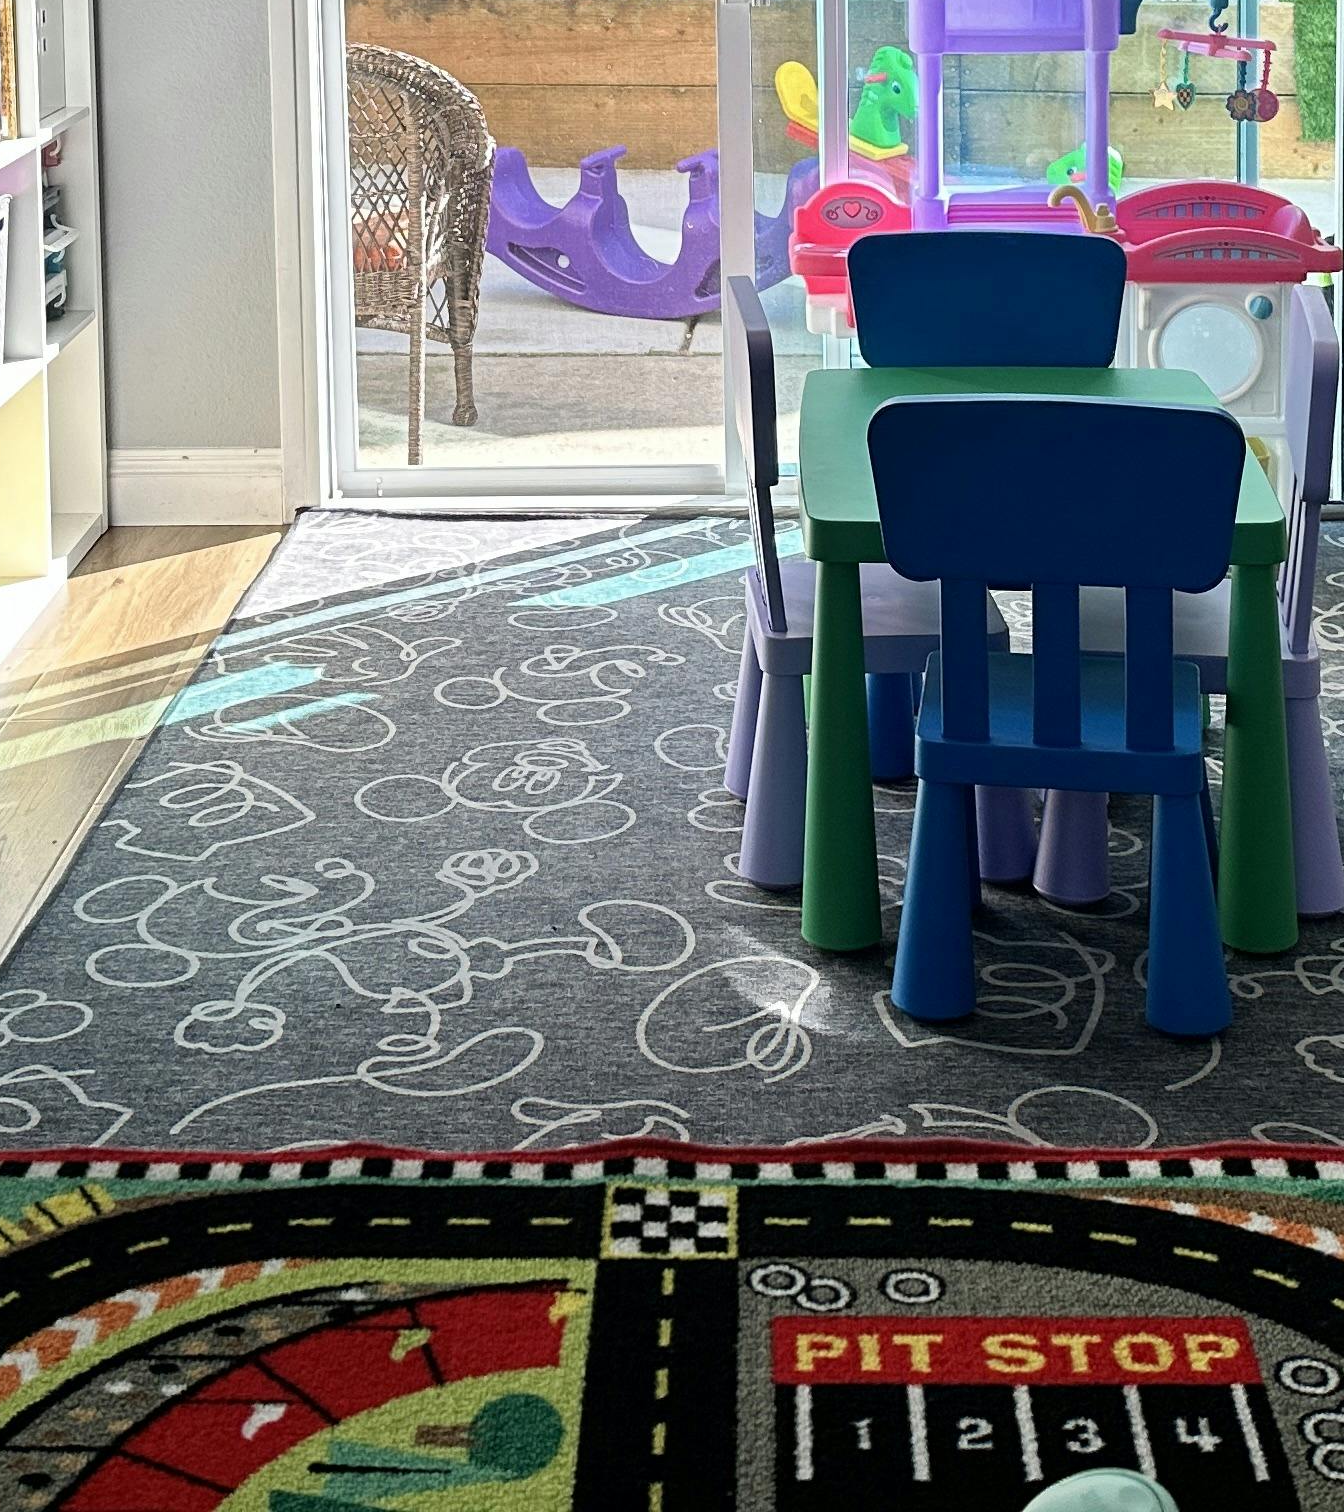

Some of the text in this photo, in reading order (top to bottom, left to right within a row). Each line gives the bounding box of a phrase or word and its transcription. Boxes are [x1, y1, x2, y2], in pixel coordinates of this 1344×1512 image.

[793, 1331, 1241, 1374] PIT STOP
[850, 1416, 1223, 1454] 1 2 3 4
